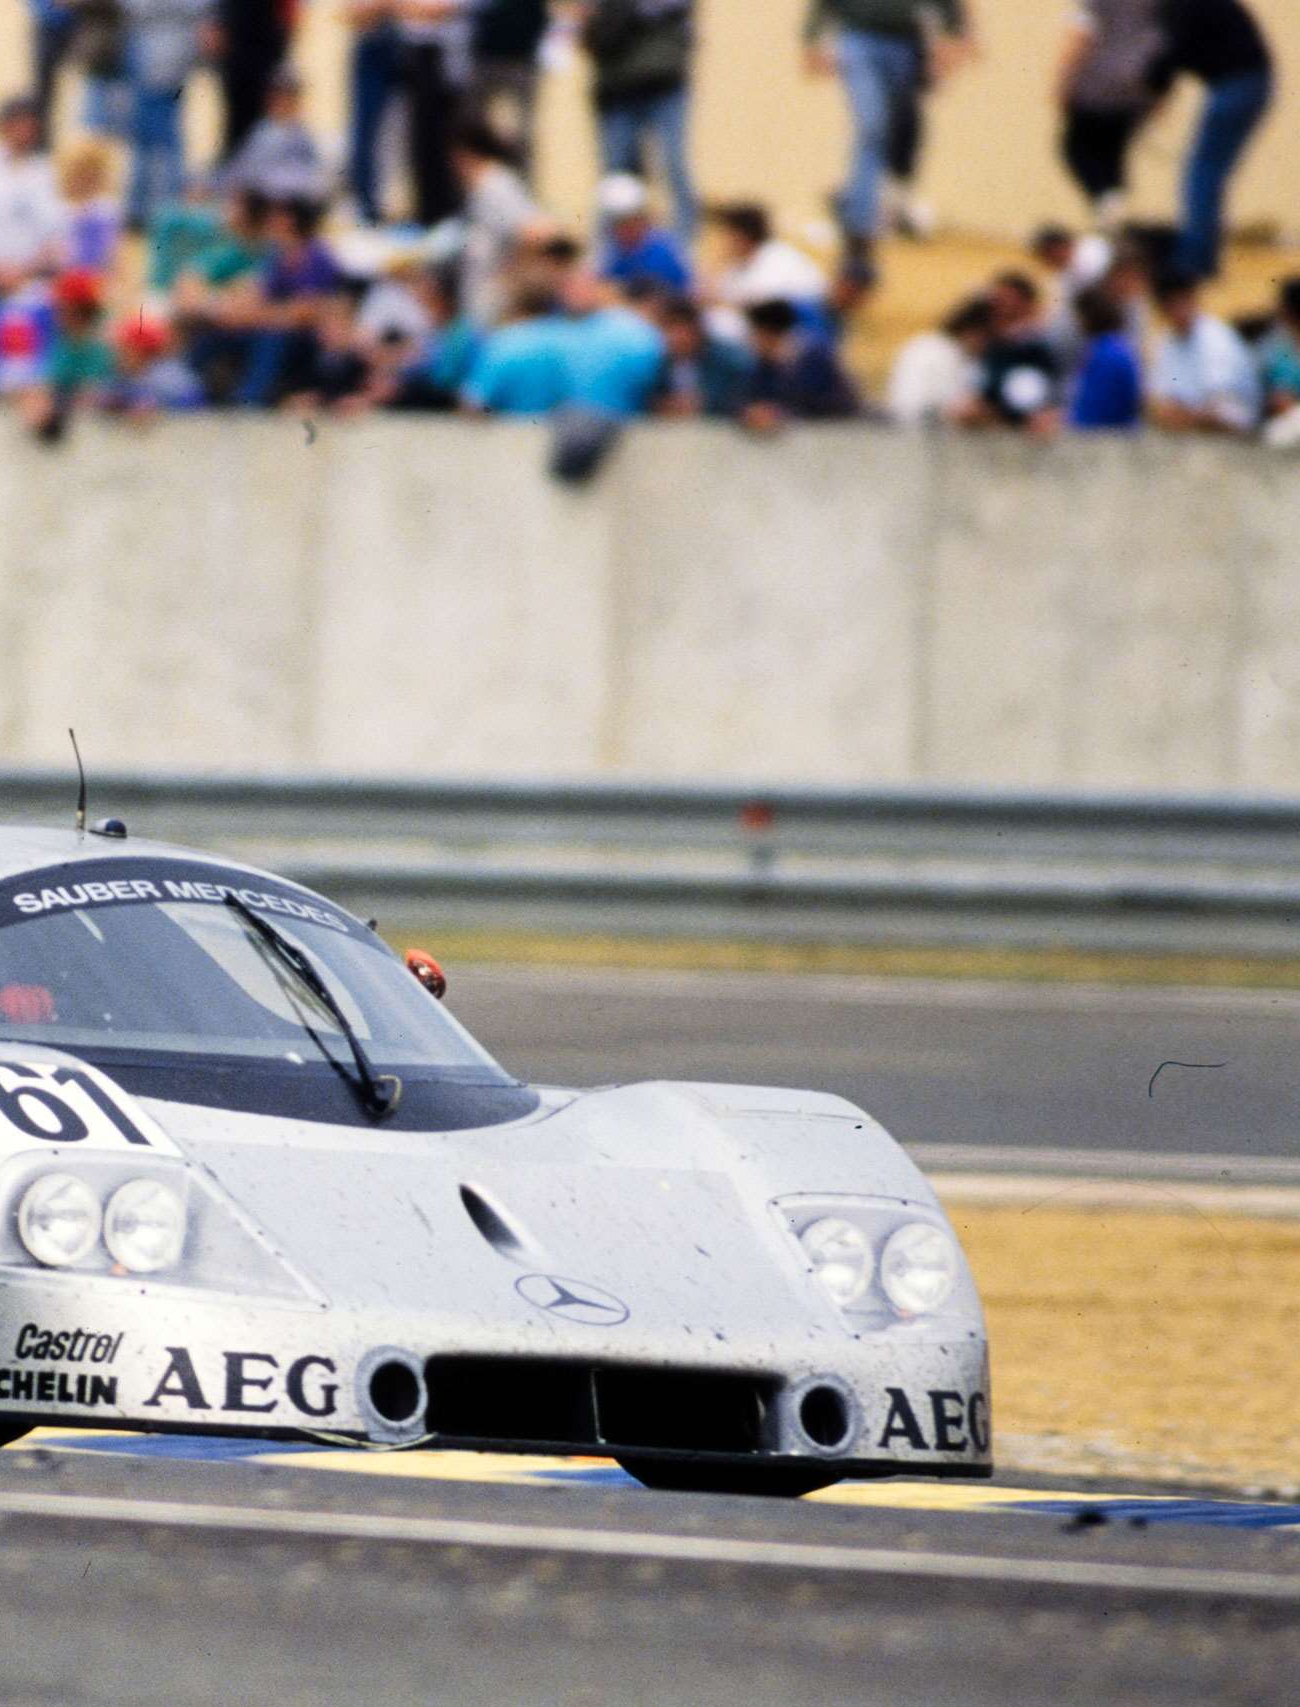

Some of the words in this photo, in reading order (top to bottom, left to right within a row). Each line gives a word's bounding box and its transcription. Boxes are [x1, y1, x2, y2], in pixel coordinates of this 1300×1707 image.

[13, 879, 162, 913] SAUBER
[15, 1323, 124, 1364] Castrol
[143, 1346, 340, 1417] AEG
